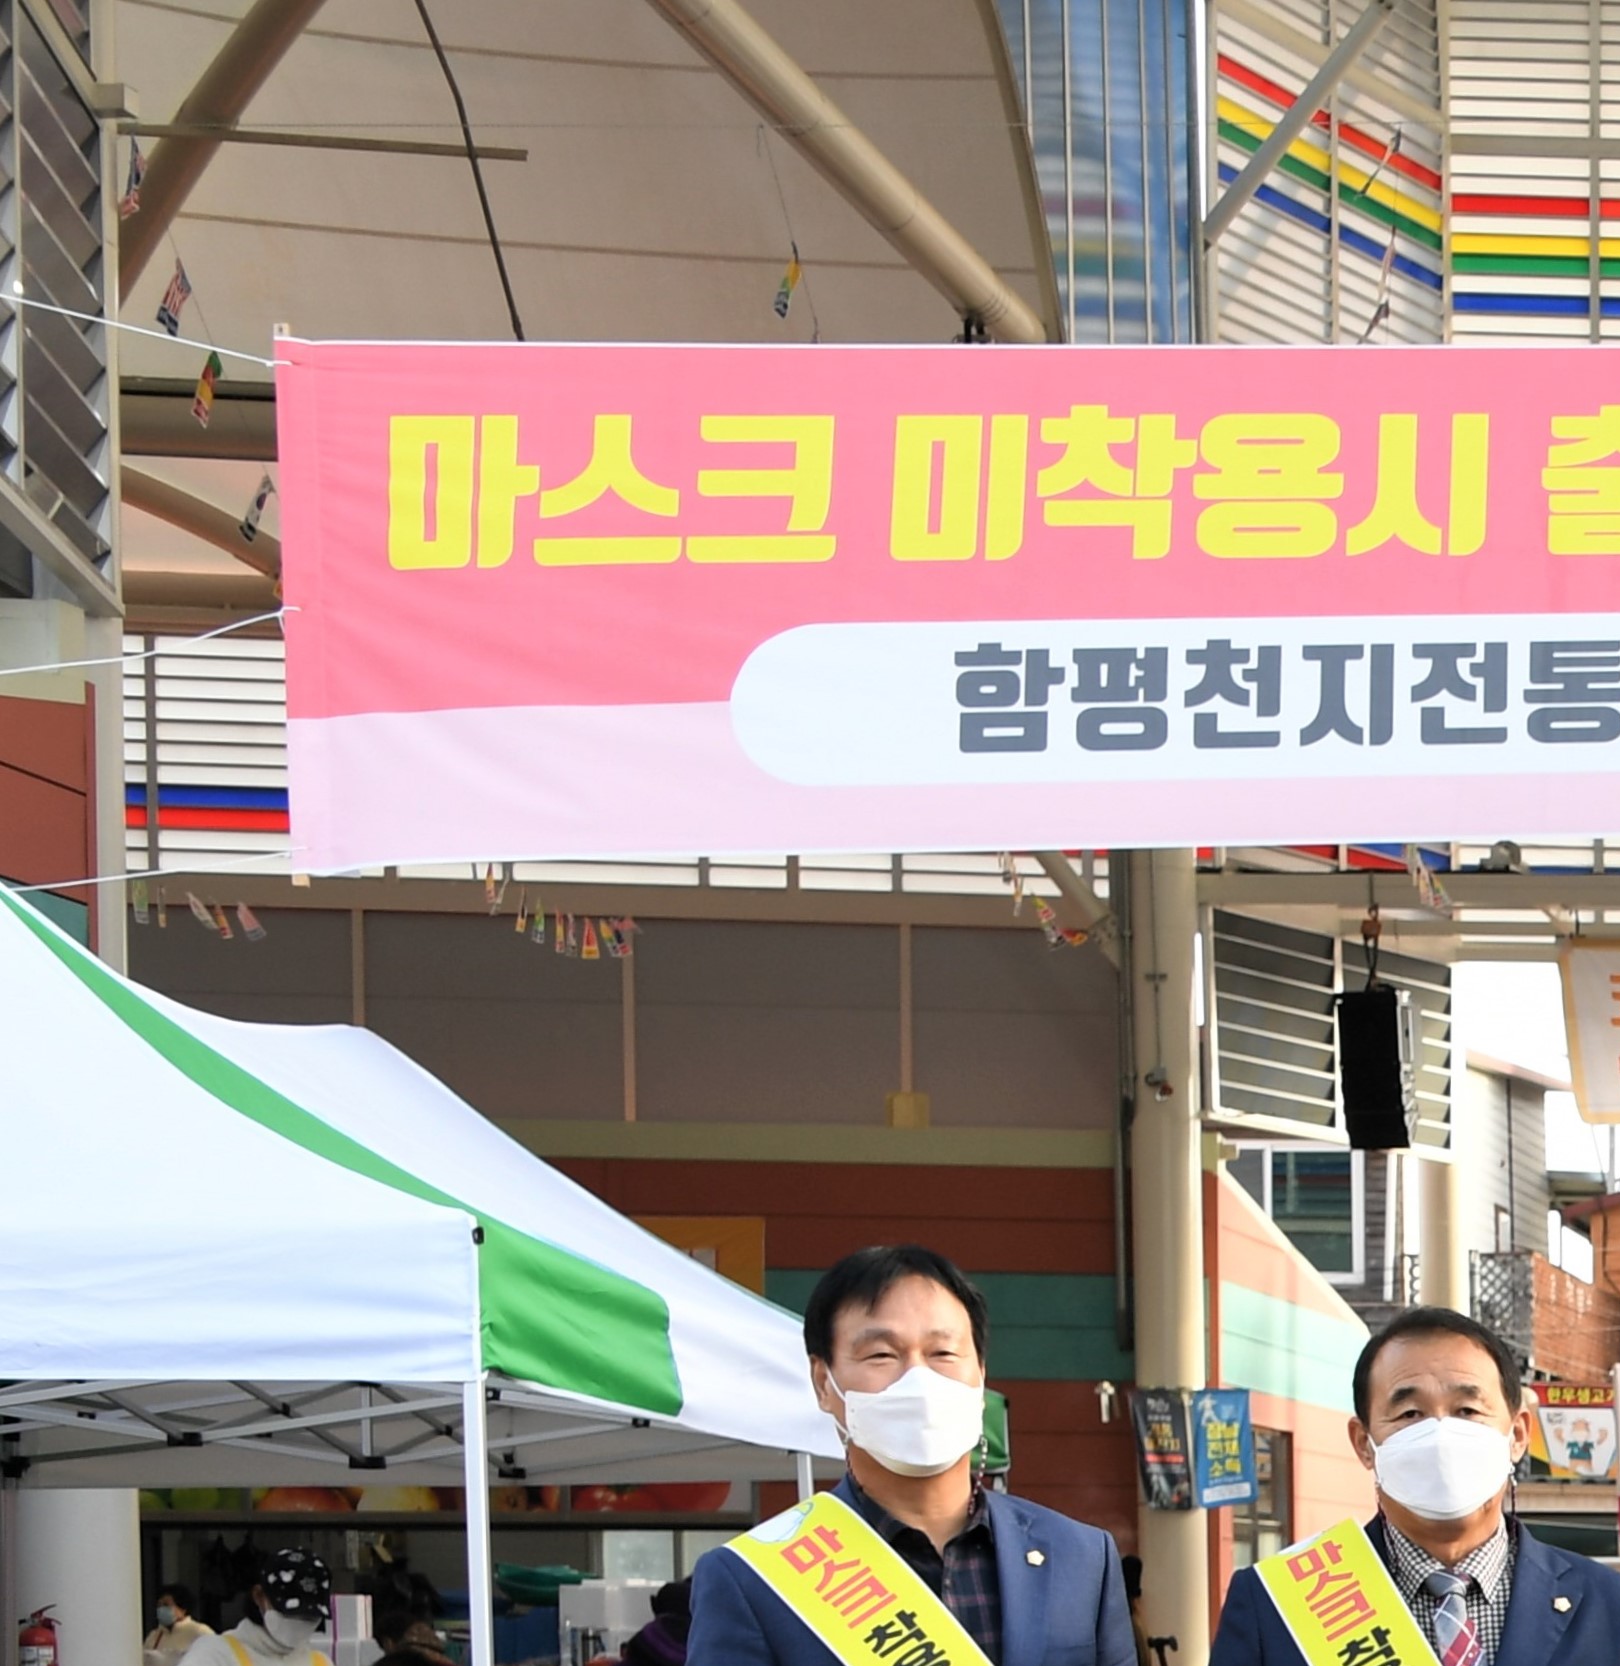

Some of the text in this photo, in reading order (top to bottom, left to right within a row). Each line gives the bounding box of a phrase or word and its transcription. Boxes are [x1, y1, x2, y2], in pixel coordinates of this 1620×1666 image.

[388, 413, 837, 570] 마스크
[889, 403, 1490, 561] 미착용시
[779, 1524, 898, 1629] 마스크
[1285, 1540, 1377, 1642] 마스크
